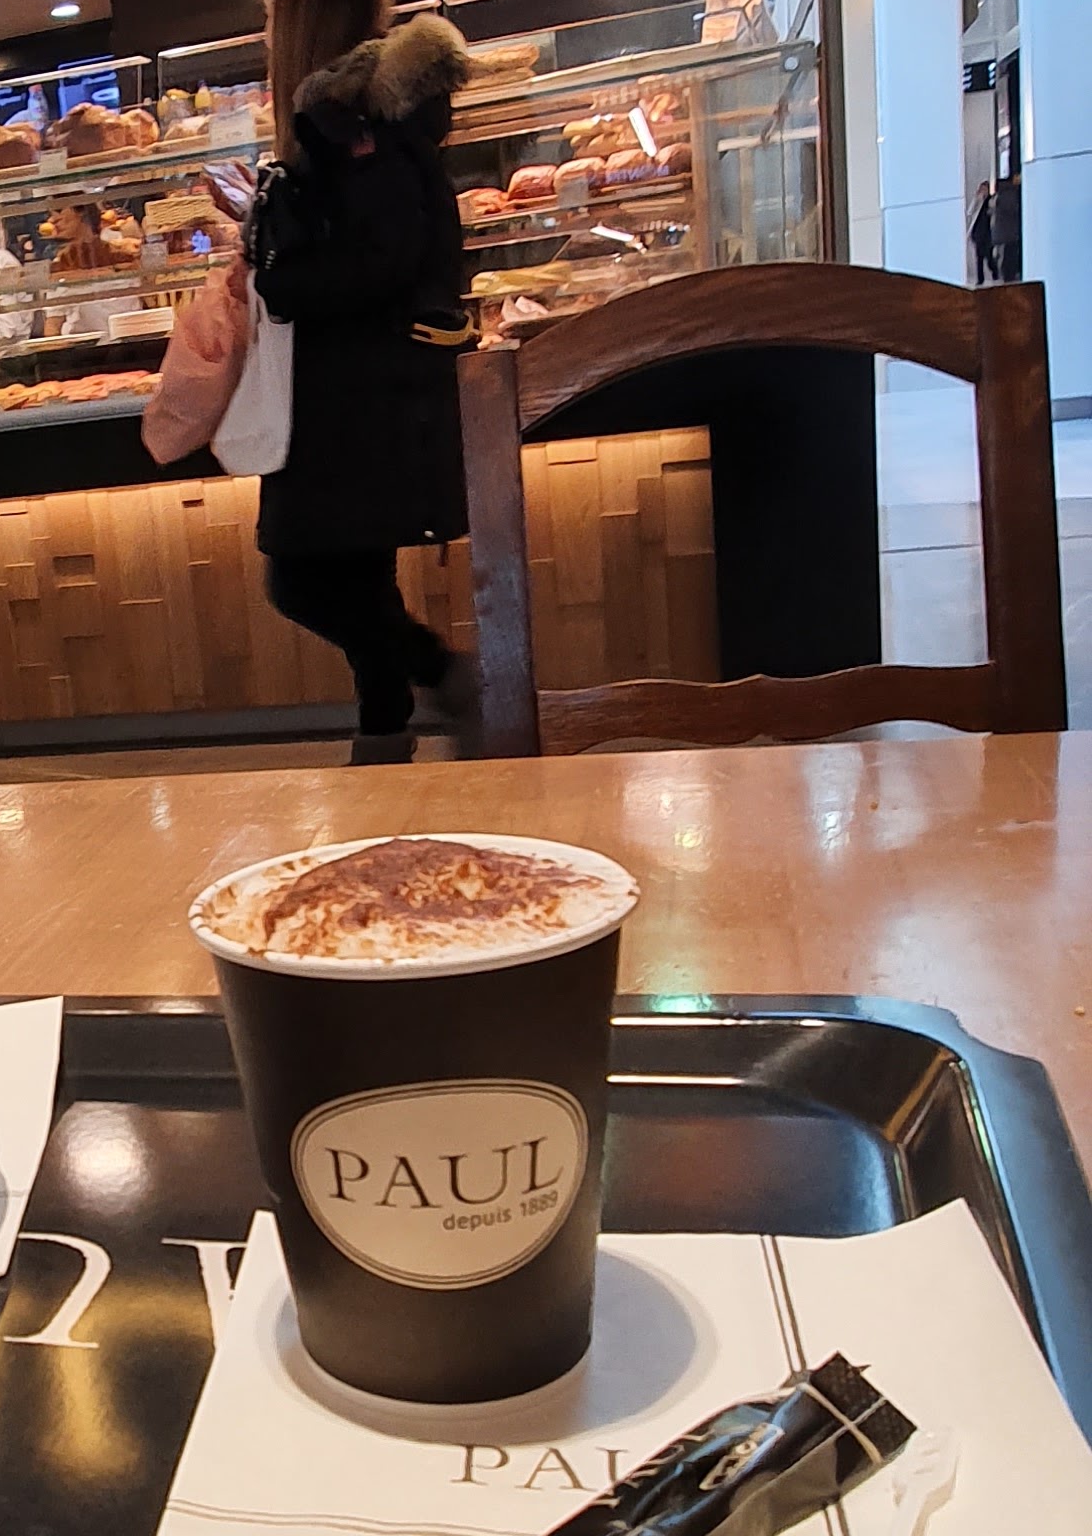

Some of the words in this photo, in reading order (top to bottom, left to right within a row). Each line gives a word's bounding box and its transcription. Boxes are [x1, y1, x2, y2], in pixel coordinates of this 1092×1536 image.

[324, 1136, 564, 1209] PAUL
[442, 1206, 512, 1232] depuis
[519, 1190, 559, 1217] 1889
[450, 1443, 630, 1492] PA
